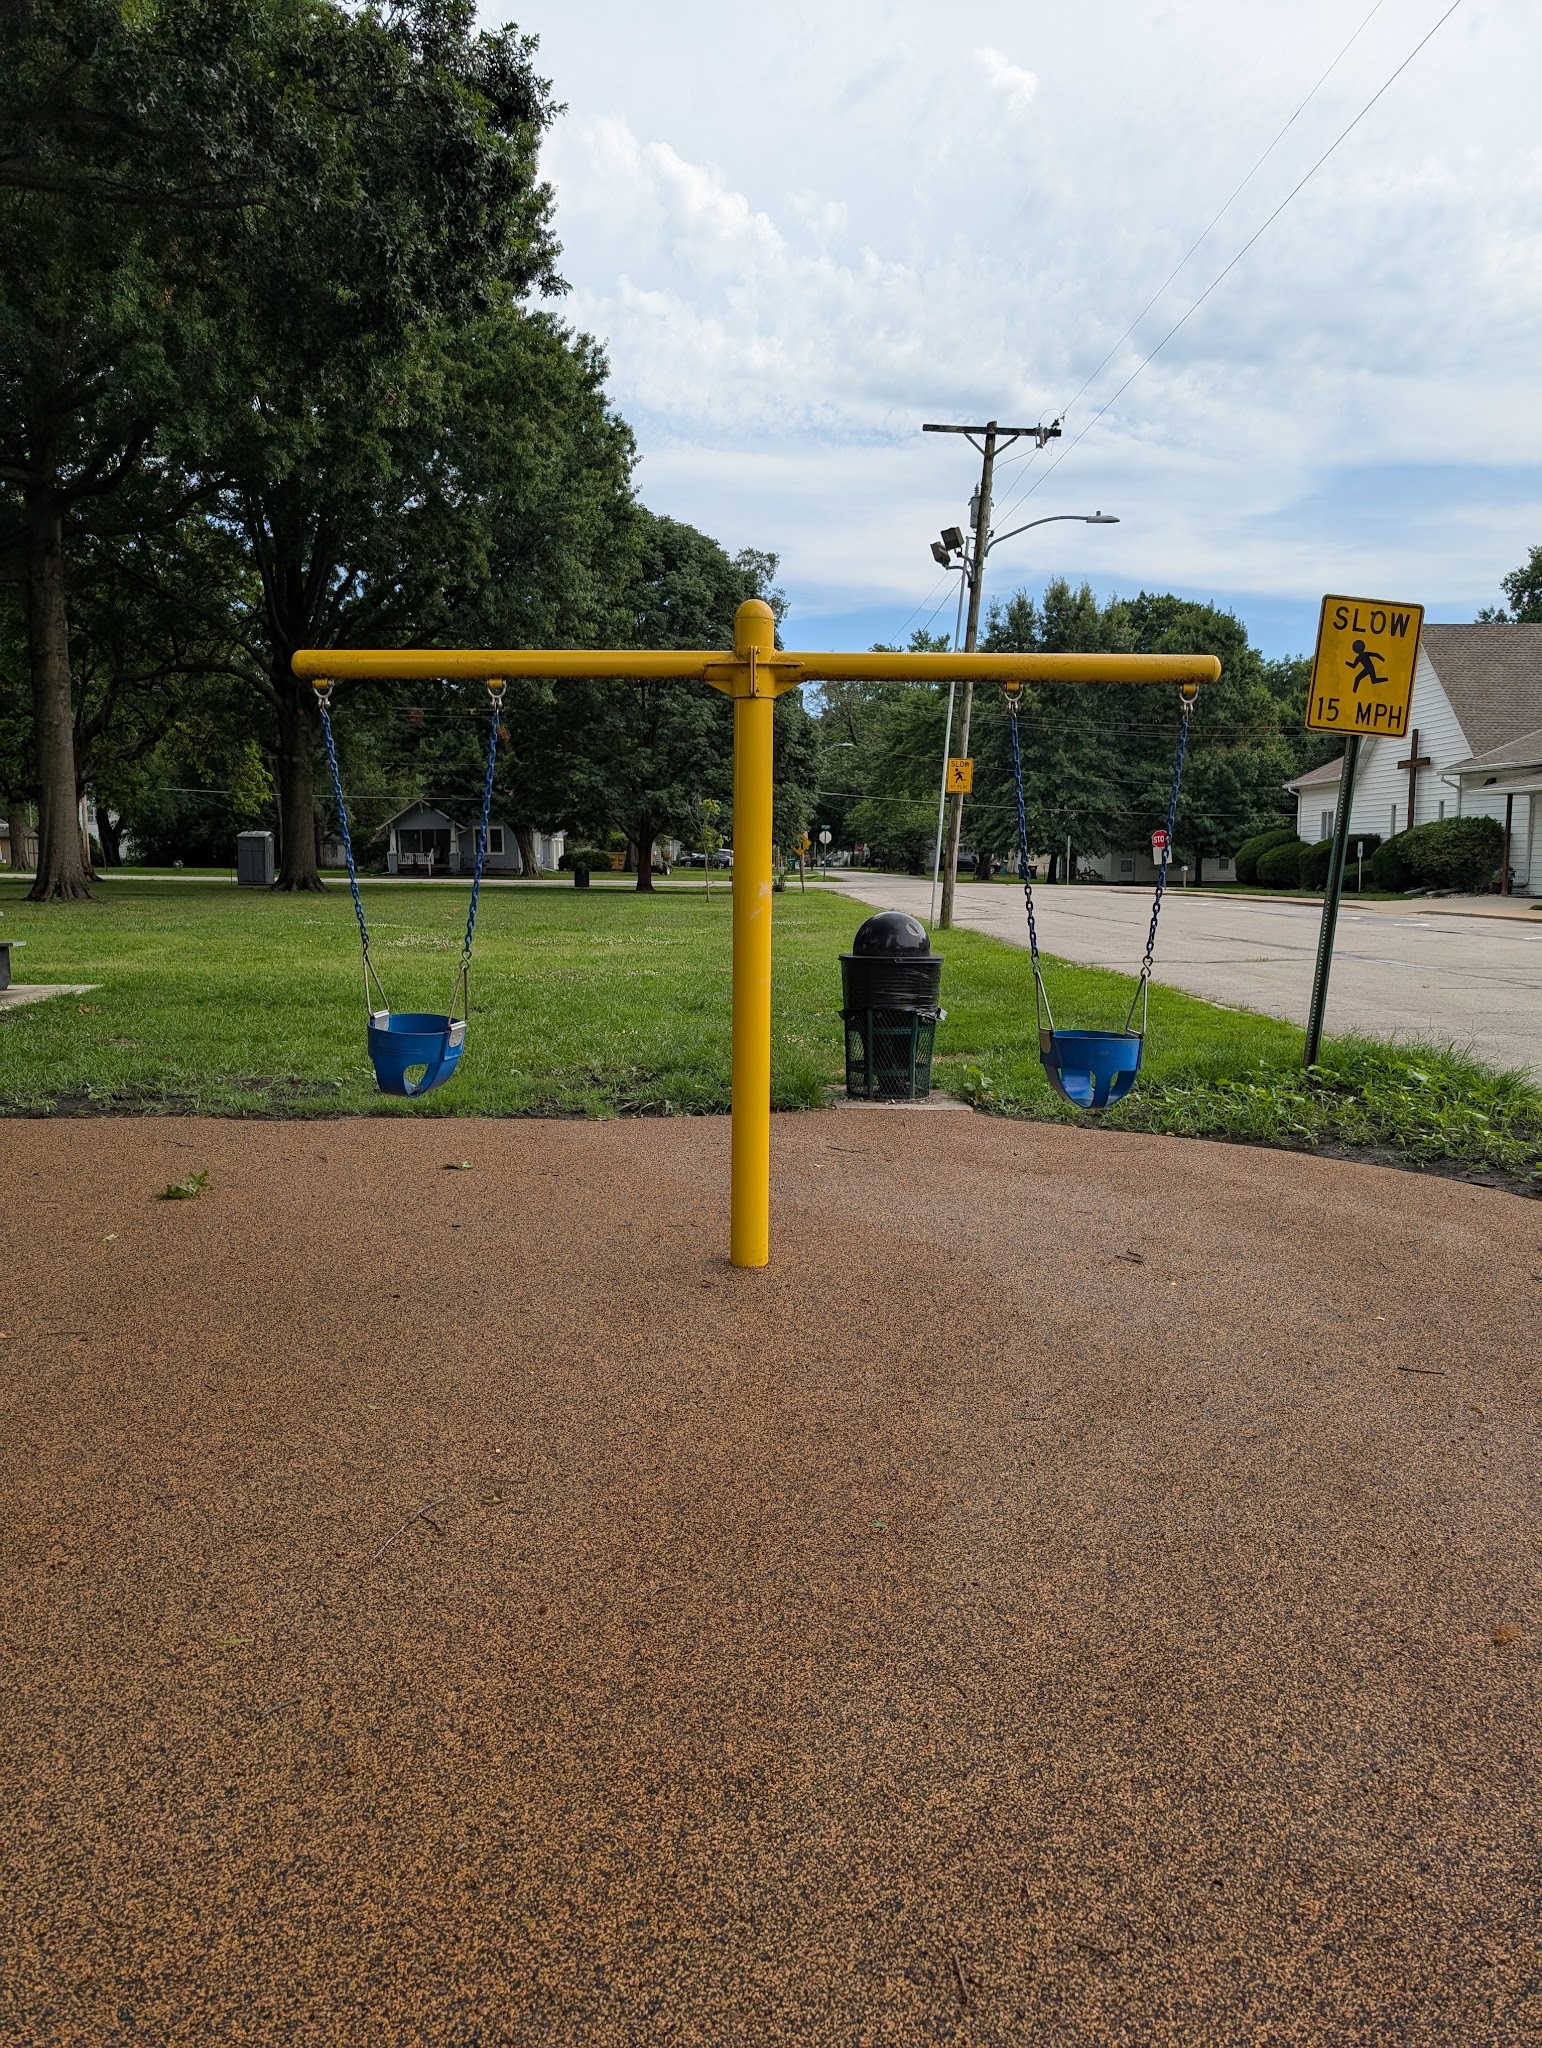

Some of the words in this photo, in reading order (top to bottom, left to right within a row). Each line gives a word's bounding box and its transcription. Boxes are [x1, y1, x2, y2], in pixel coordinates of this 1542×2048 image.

[1332, 606, 1411, 638] SLOW
[1317, 696, 1340, 722] 15
[1355, 701, 1403, 729] MPH
[950, 760, 970, 768] SLOW
[1153, 835, 1168, 843] STO
